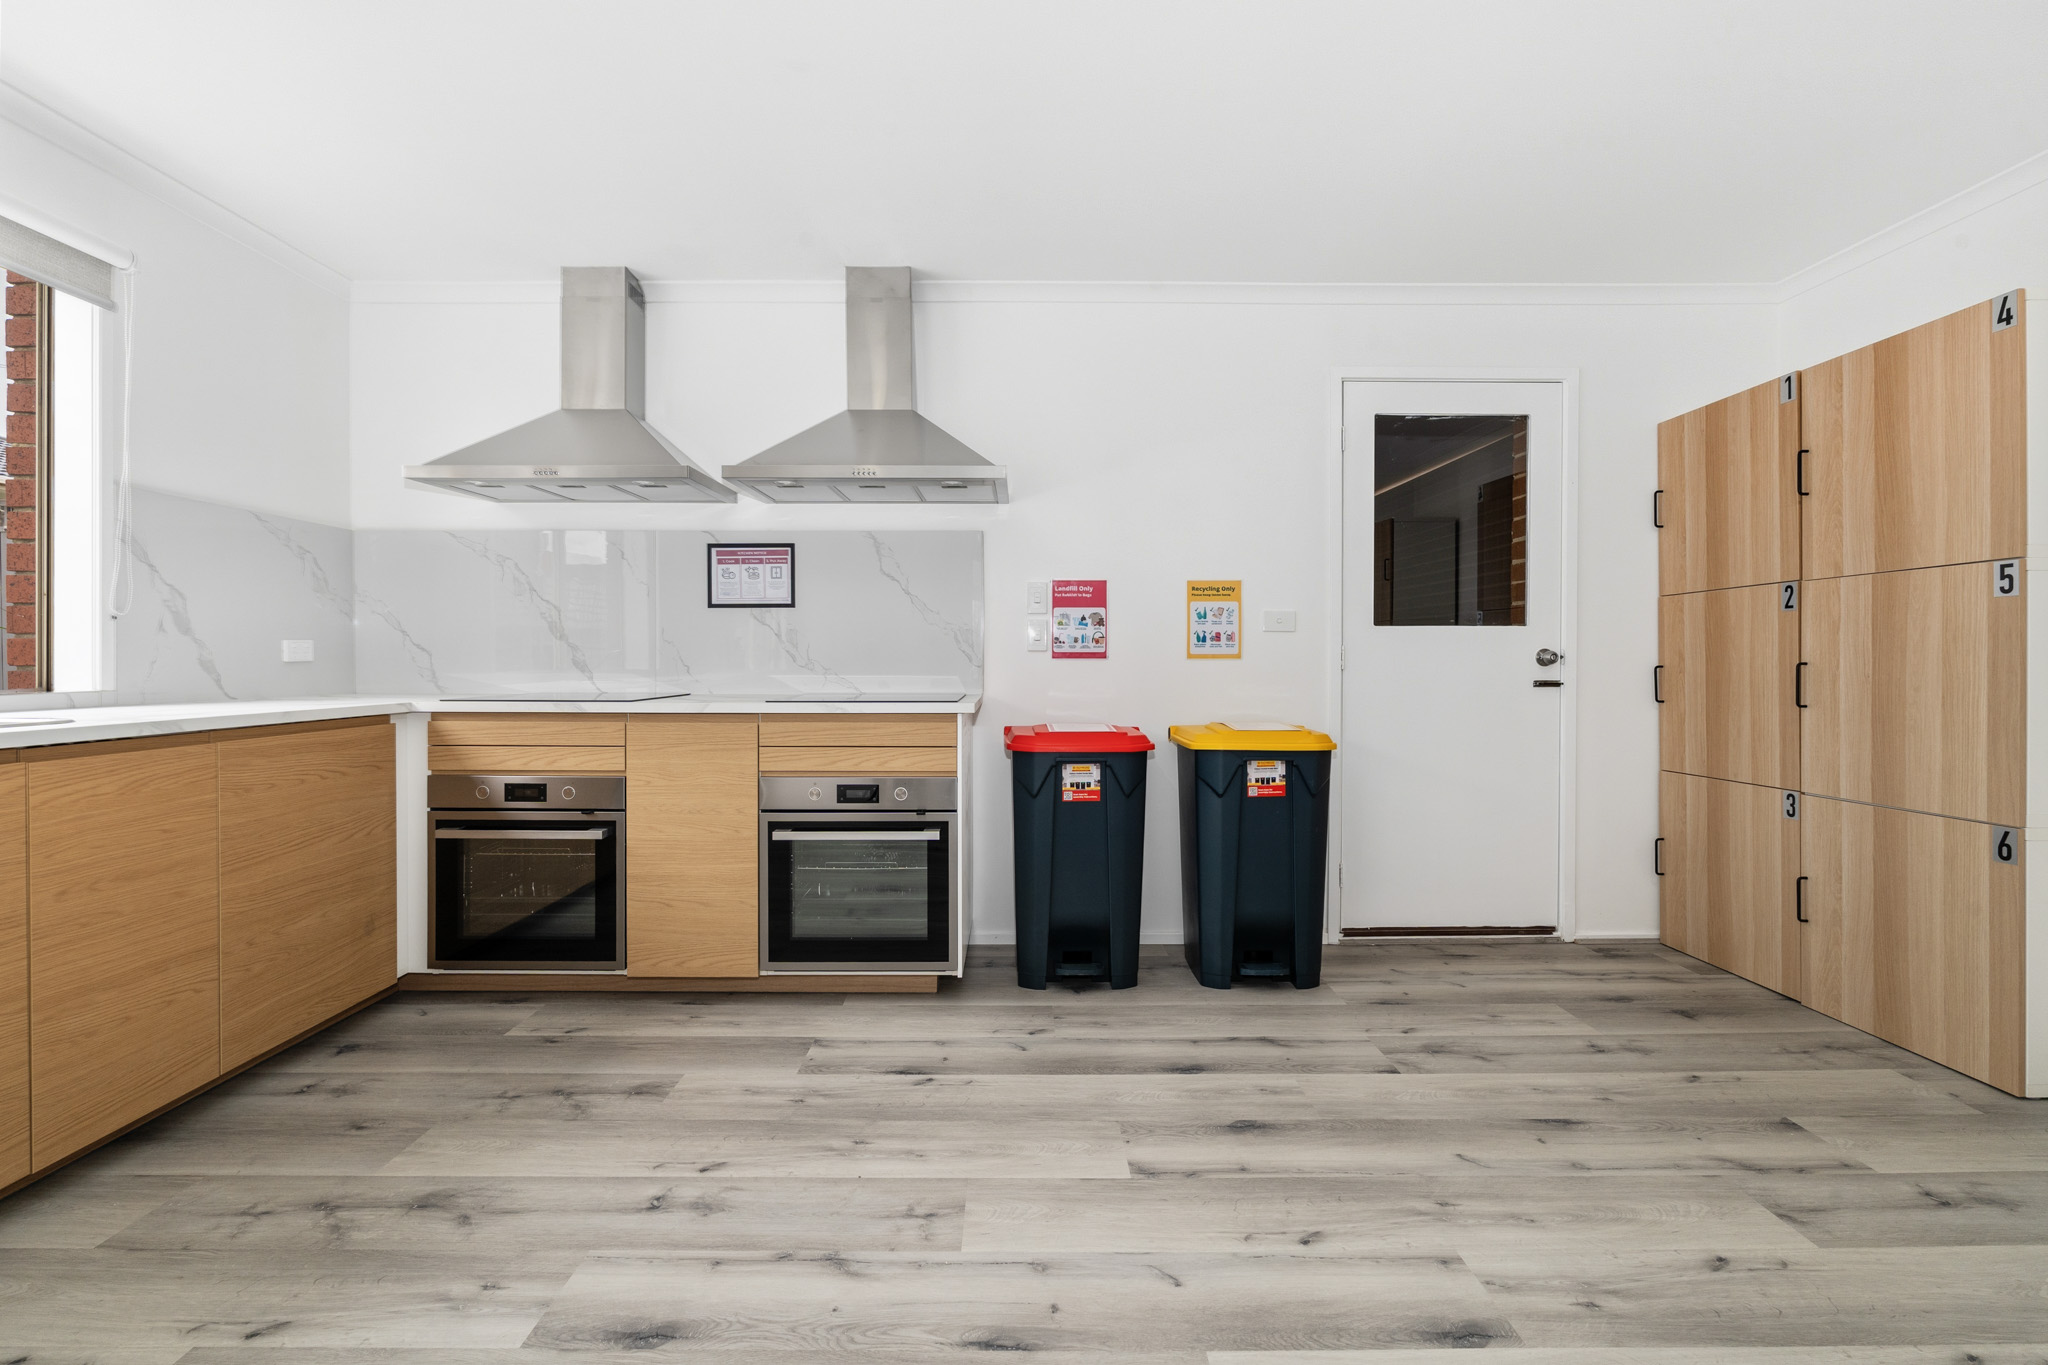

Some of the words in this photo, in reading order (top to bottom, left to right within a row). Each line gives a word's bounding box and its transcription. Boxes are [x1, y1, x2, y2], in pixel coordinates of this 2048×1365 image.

[1996, 295, 2014, 326] 4
[1784, 375, 1793, 401] 1
[1999, 563, 2015, 595] 5
[1784, 585, 1795, 610] 2
[1786, 793, 1796, 818] 3
[1997, 830, 2013, 861] 6
